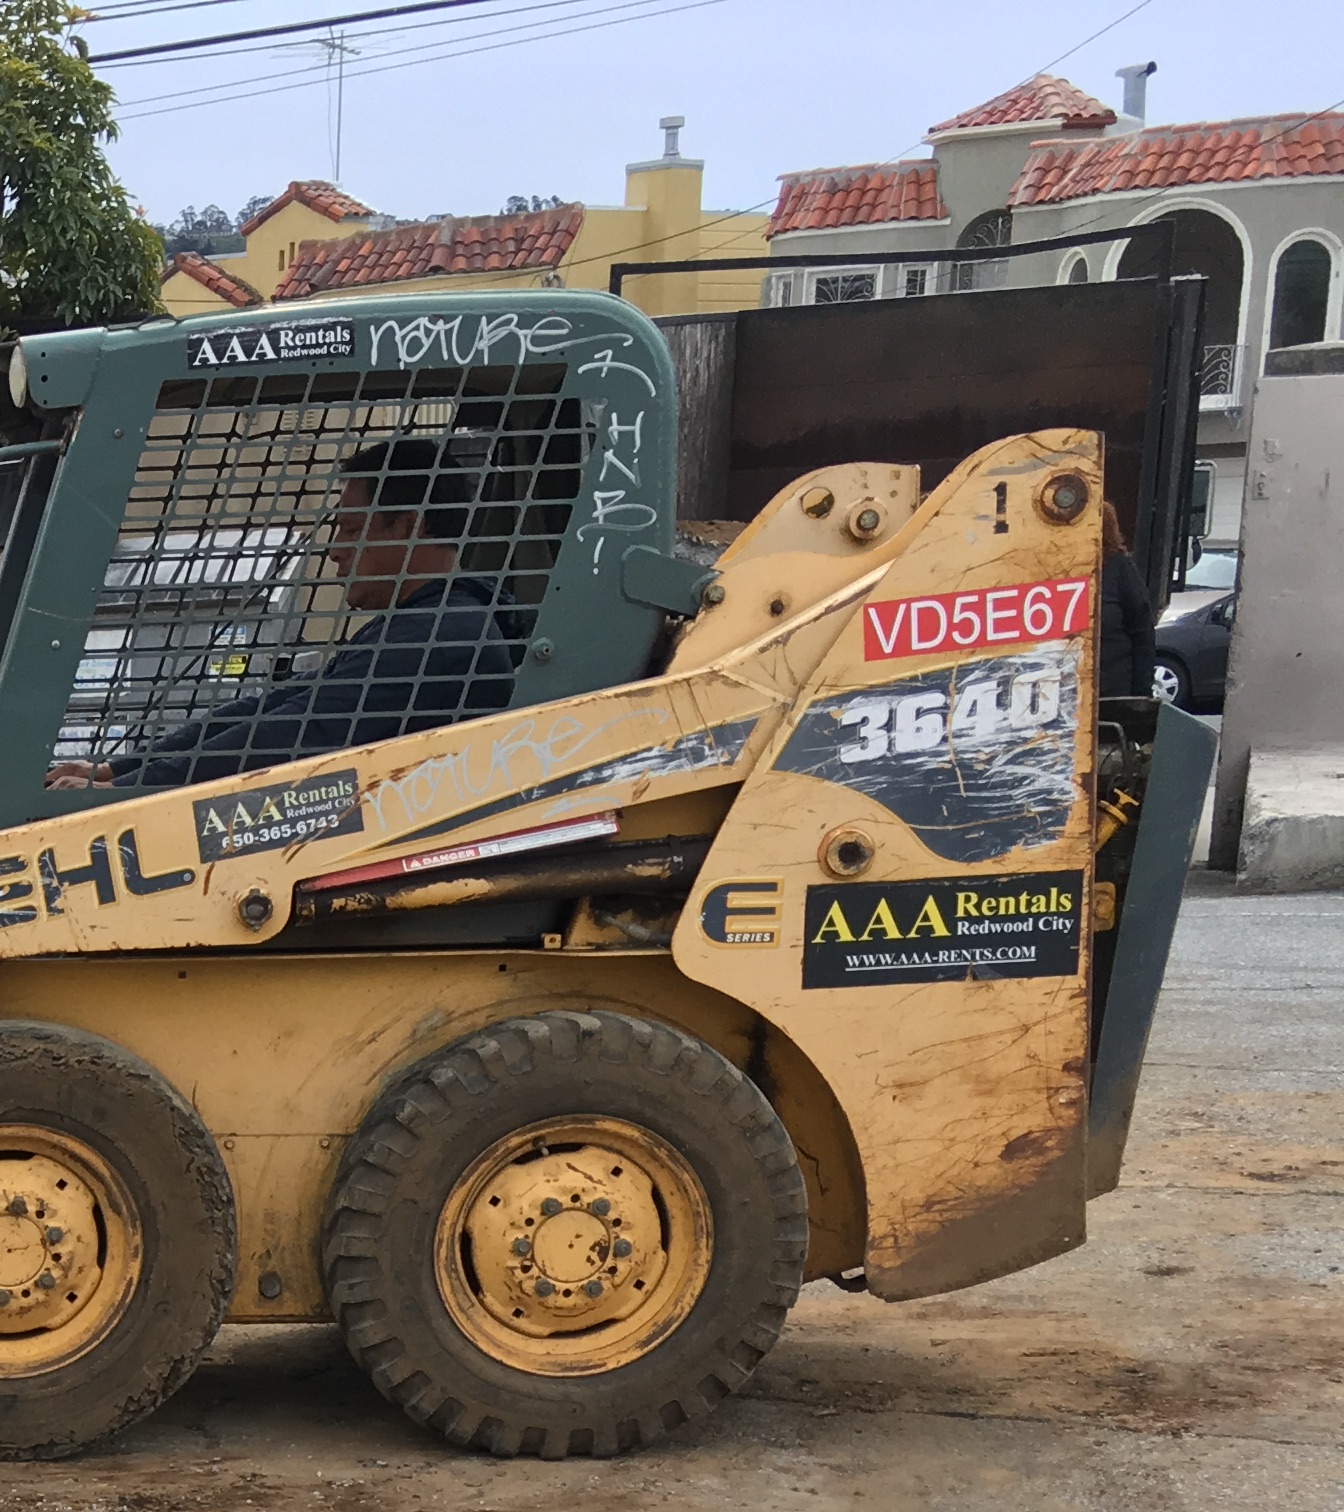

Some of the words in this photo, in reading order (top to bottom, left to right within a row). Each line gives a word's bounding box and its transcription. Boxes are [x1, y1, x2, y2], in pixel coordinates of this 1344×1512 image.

[192, 331, 278, 367] AAA
[279, 326, 351, 347] Rentals
[280, 344, 327, 358] Redwood
[329, 342, 352, 356] City
[991, 480, 1009, 534] 1
[867, 581, 1086, 654] VD5E67
[838, 668, 1062, 764] 3640
[201, 796, 284, 837] AAA
[282, 780, 354, 808] Rentals
[286, 802, 332, 818] Redwood
[335, 797, 356, 811] City
[221, 814, 340, 848] 650-365-6743
[423, 849, 476, 866] DANGER
[699, 880, 780, 946] E
[811, 894, 952, 944] AAA
[955, 887, 1073, 918] Rentals
[956, 917, 1033, 936] Redwood
[1038, 916, 1075, 934] City
[726, 933, 771, 943] SERIES
[845, 945, 1037, 968] WWW.AAA-RENTS.COM
